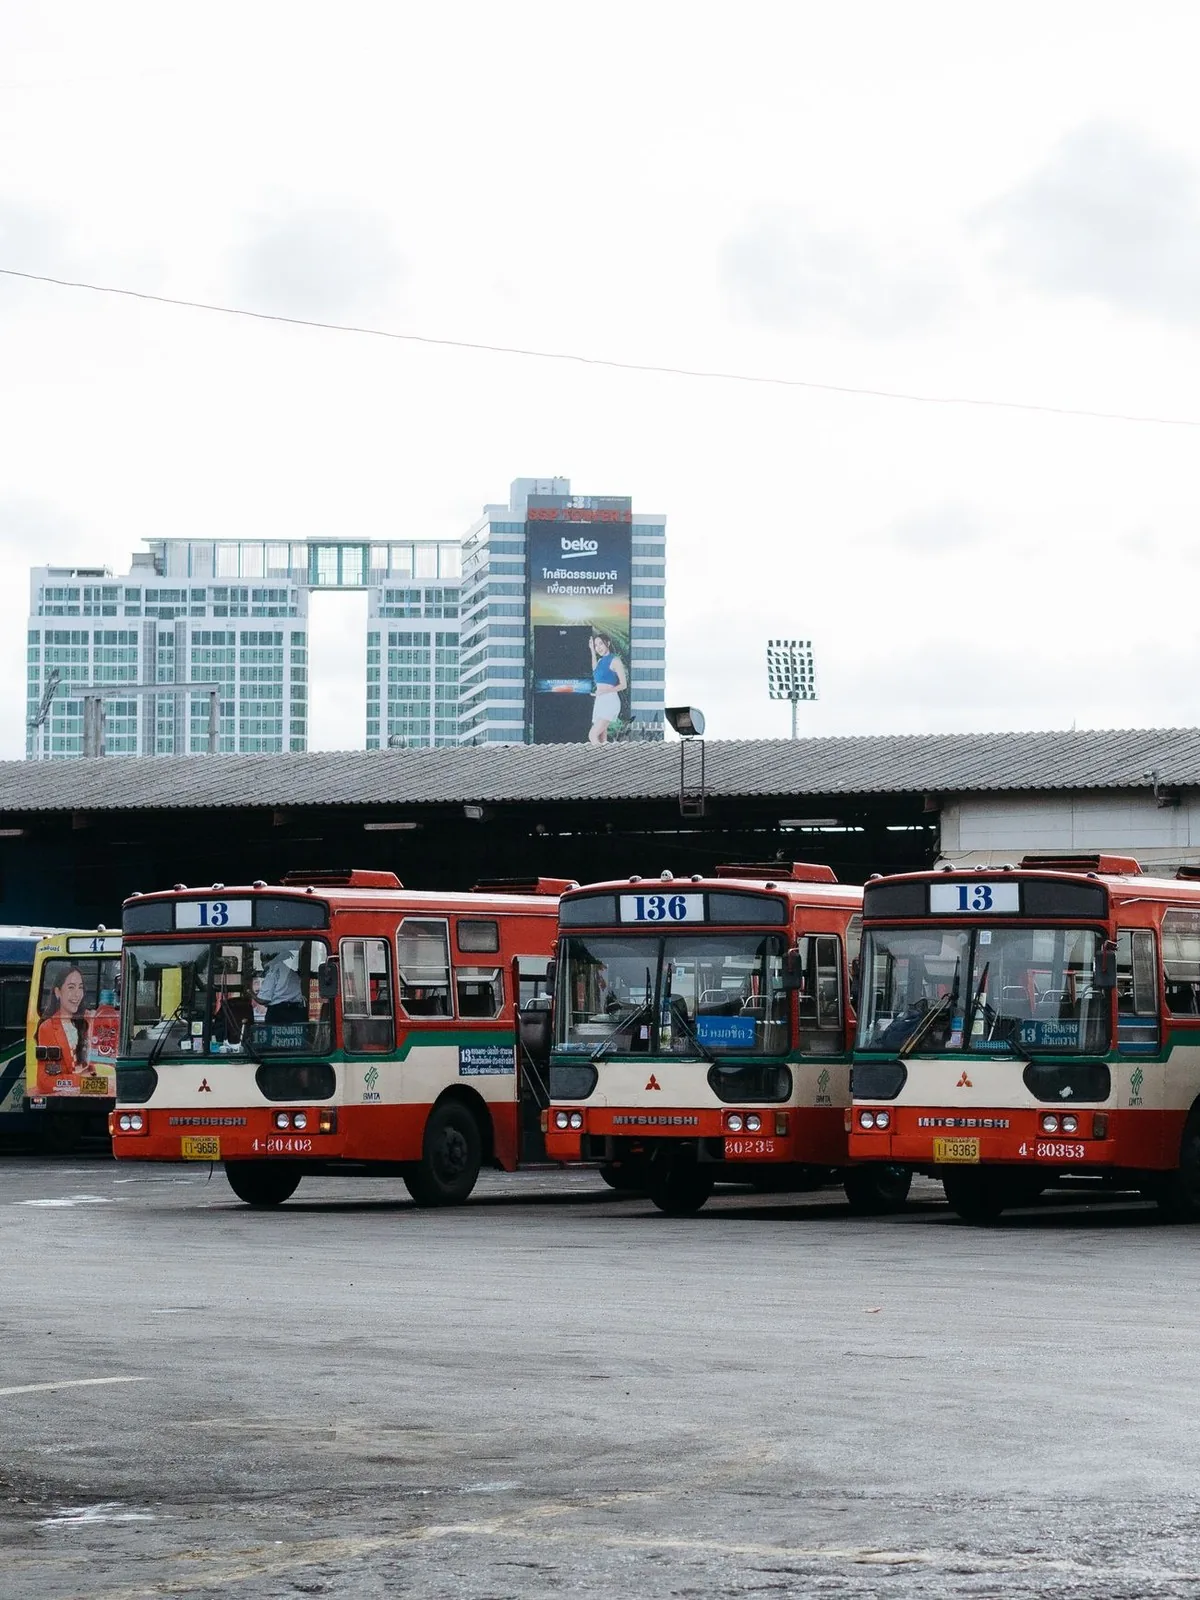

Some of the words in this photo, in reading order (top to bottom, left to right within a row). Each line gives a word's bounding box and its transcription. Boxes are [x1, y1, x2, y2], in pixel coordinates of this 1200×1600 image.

[561, 537, 598, 551] beko
[542, 567, 618, 581] ใกล้ชิดธรรมชาติ
[547, 581, 614, 597] เพื่อสุขภาพที่ดี
[956, 885, 993, 911] 13
[197, 902, 229, 926] 13
[634, 895, 687, 921] 136
[89, 938, 105, 952] 47
[252, 1030, 267, 1043] 13
[748, 1029, 753, 1039] 2
[1019, 1028, 1036, 1043] 13
[461, 1048, 471, 1063] 13
[363, 1092, 381, 1100] BMTA
[169, 1116, 247, 1126] MITSUBISHI
[612, 1115, 698, 1126] MITSUBISHI
[725, 1140, 775, 1153] 80235
[938, 1144, 977, 1157] 11-9363
